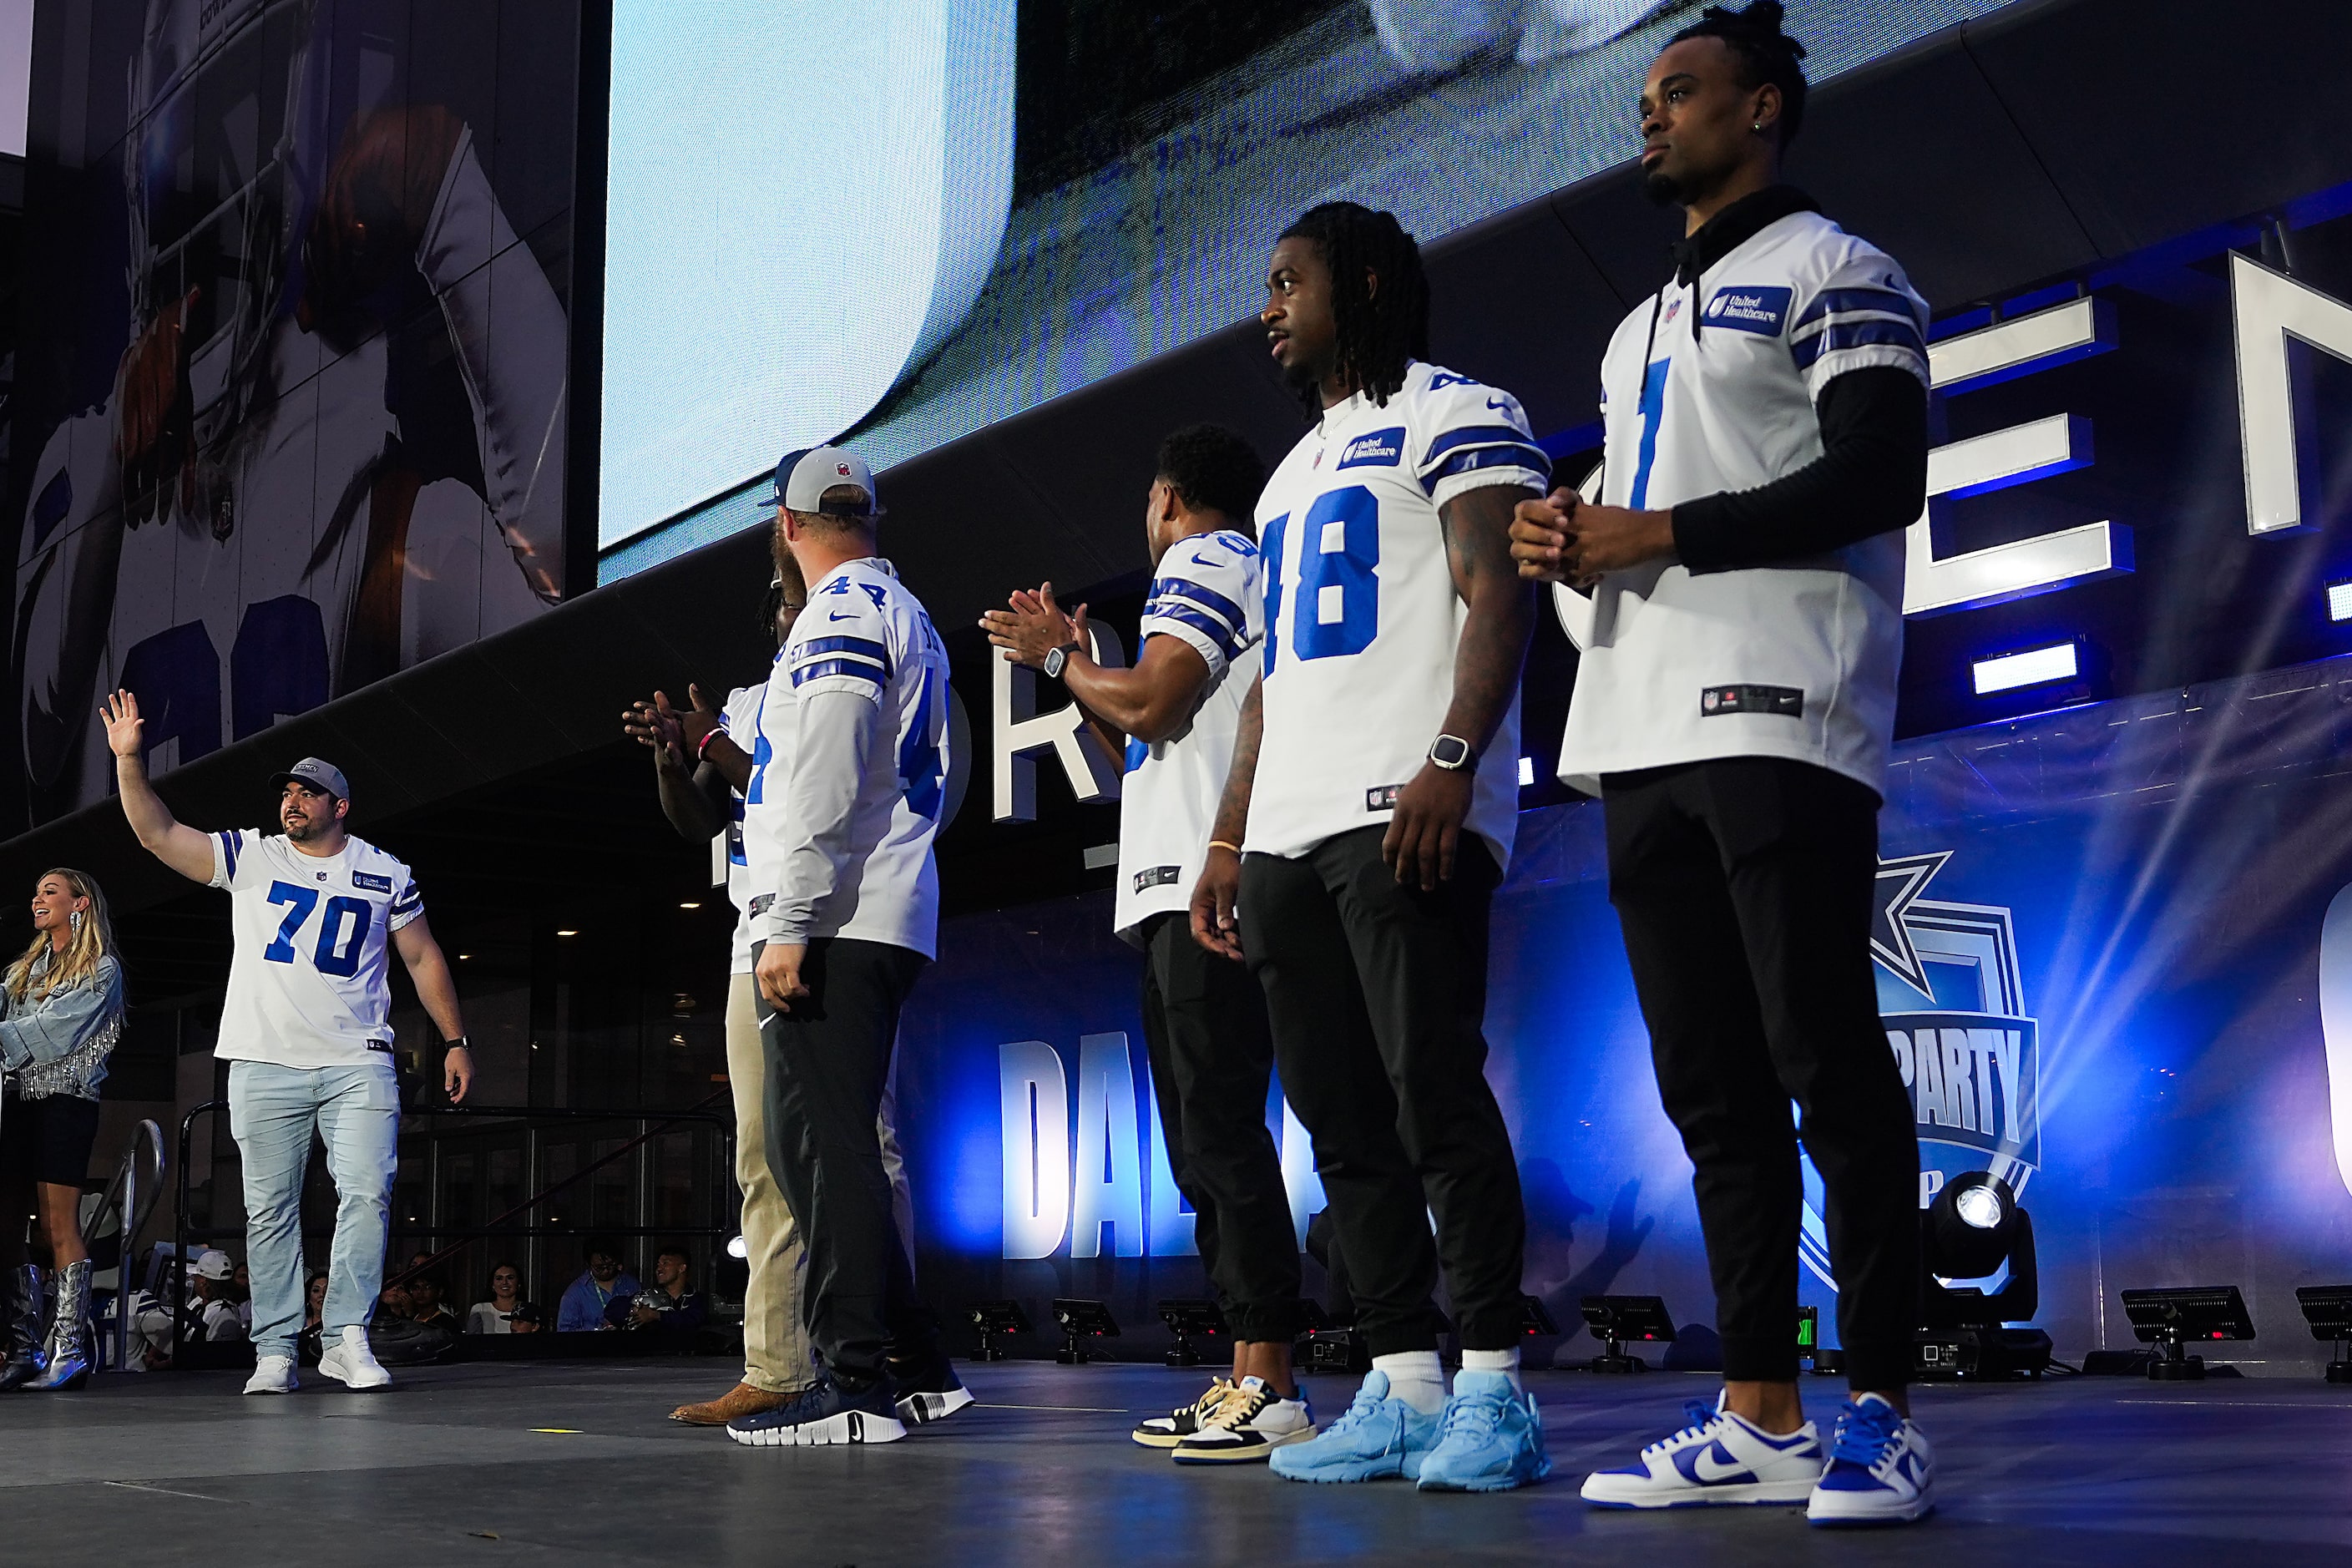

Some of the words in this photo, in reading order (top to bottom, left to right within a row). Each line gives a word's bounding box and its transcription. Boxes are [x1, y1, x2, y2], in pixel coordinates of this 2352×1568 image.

[1723, 306, 1776, 322] Healthcare
[1730, 296, 1762, 306] United
[1354, 447, 1396, 458] Healthcare
[1358, 438, 1382, 449] United
[819, 575, 888, 615] 44
[1259, 484, 1379, 681] 48
[264, 880, 373, 978] 70
[1885, 1028, 2021, 1144] PARTY
